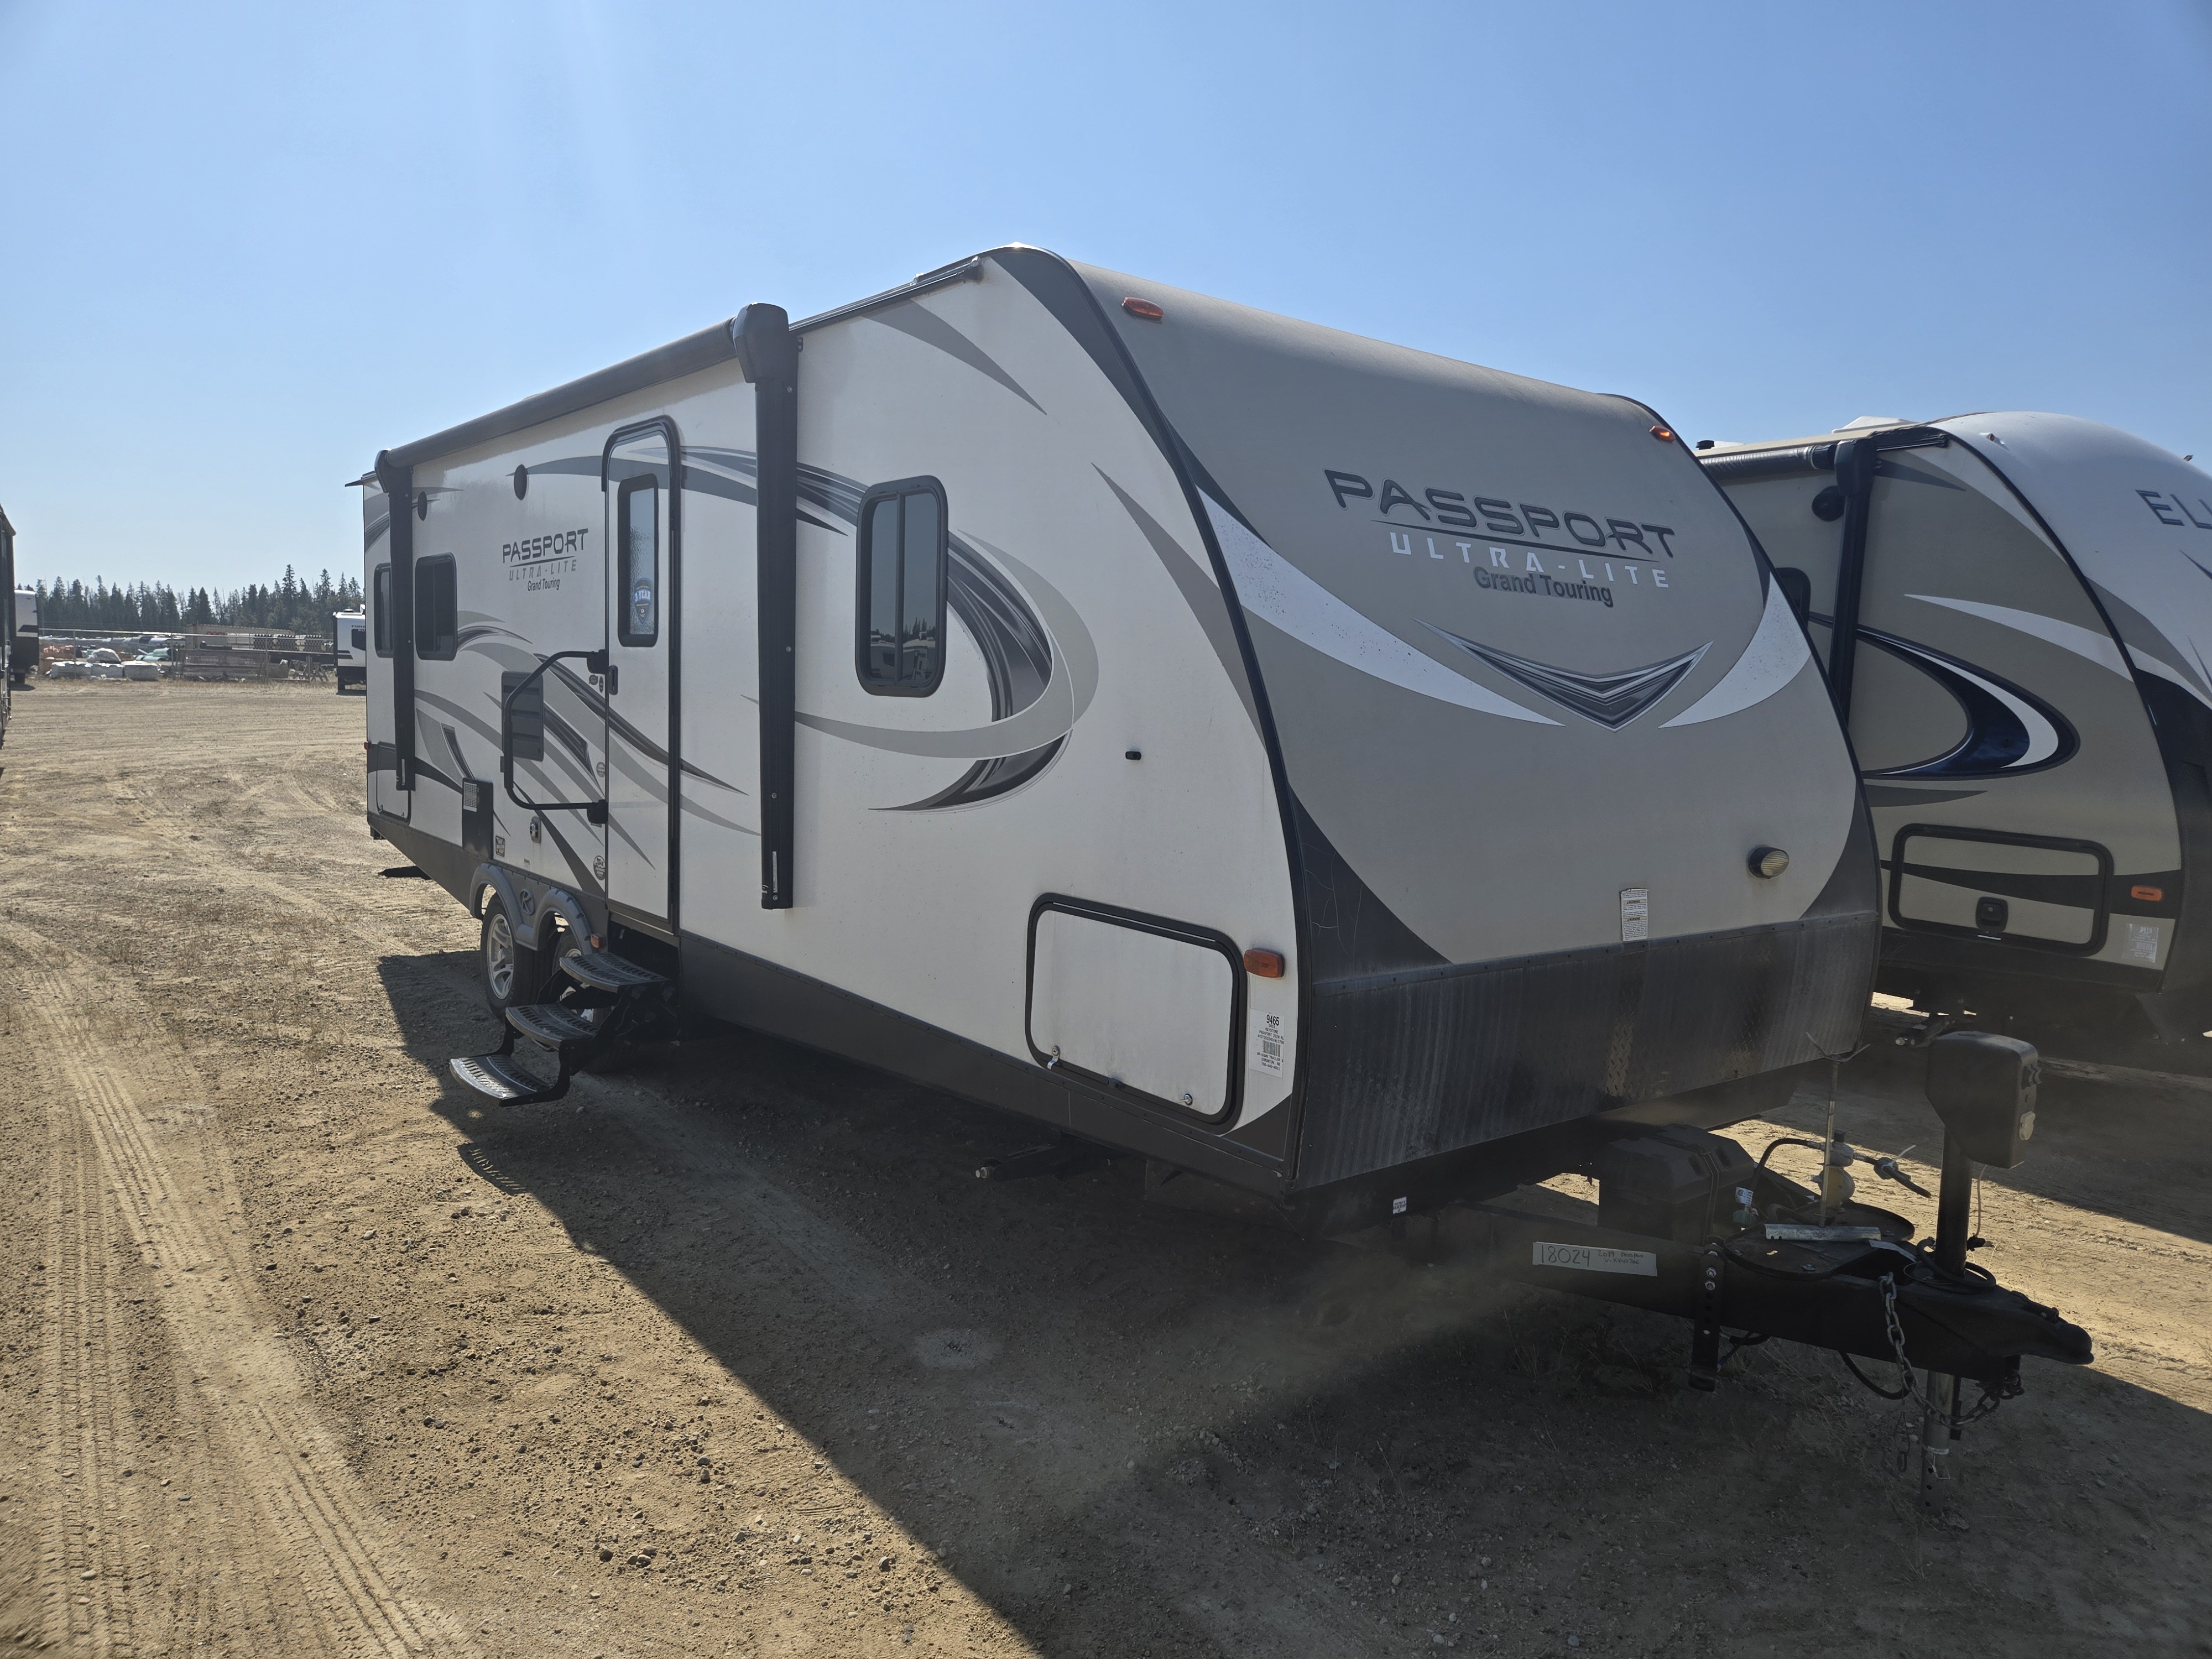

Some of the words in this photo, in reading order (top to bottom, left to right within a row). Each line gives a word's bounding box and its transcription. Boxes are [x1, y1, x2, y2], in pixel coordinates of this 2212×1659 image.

[1324, 468, 1676, 559] PASSPORT
[503, 528, 589, 564] PASSPORT
[509, 559, 577, 581] ULTRA-LITE
[1389, 531, 1670, 588] ULTRA-LITE
[527, 580, 541, 592] Grand
[542, 577, 560, 591] Touring
[638, 589, 651, 601] YEAR
[1473, 565, 1536, 594] Grand
[1541, 573, 1614, 608] Touring
[1266, 1014, 1280, 1026] 9465
[1541, 1244, 1590, 1267] 18024
